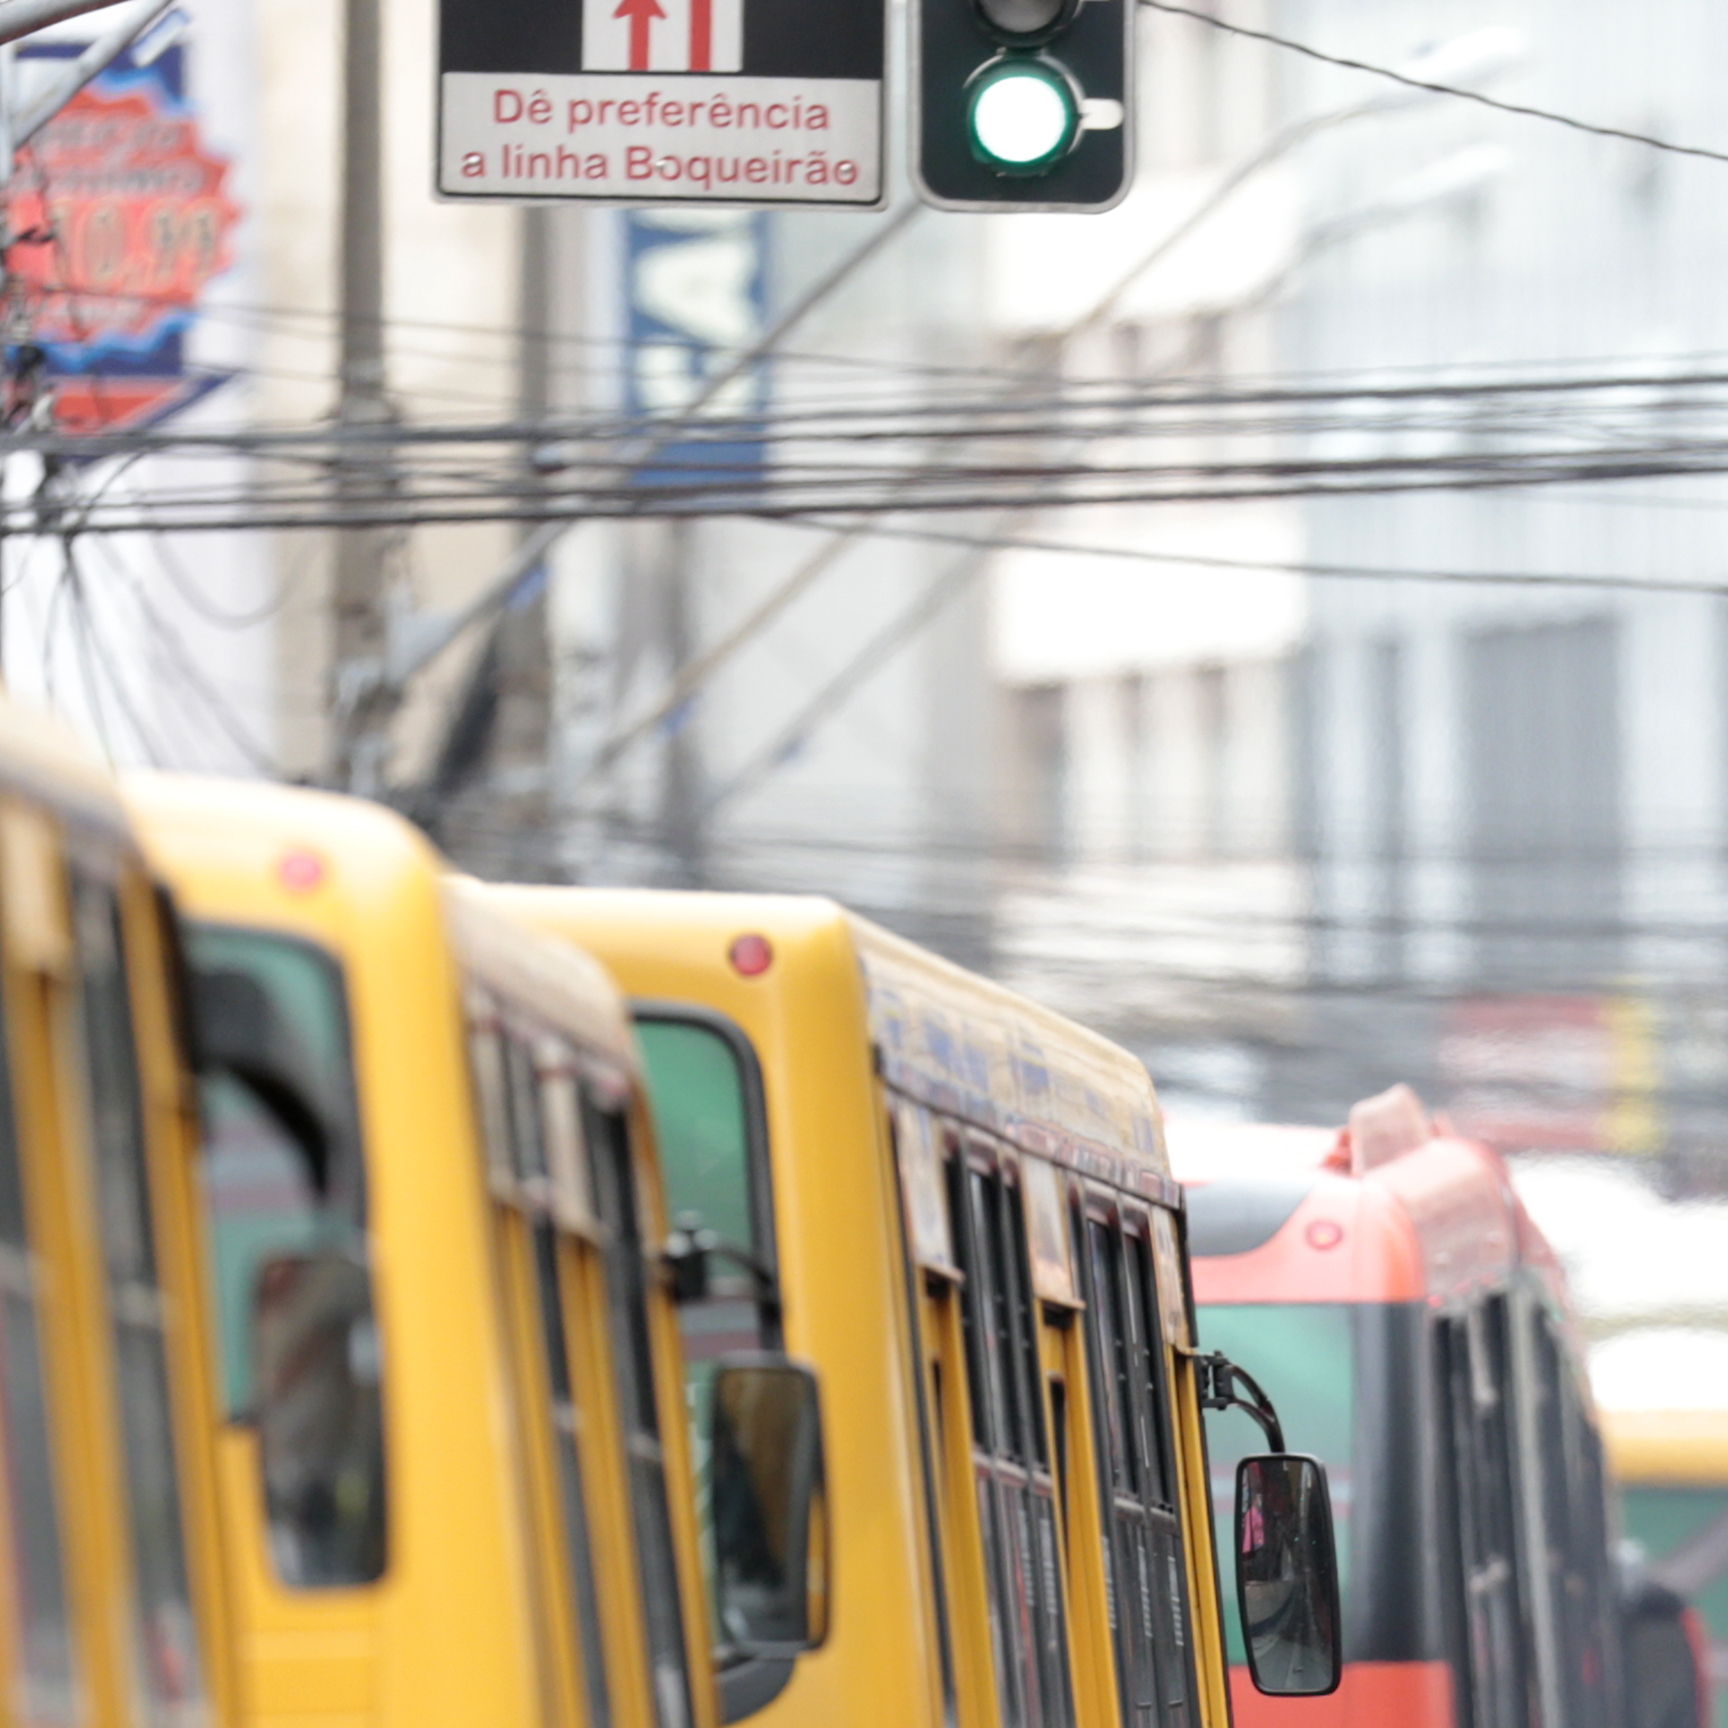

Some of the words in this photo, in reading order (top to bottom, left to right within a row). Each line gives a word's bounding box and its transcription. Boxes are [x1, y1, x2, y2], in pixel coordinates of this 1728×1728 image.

[492, 89, 554, 125] Dê
[568, 92, 830, 133] preferência
[460, 150, 486, 180] a
[500, 144, 609, 181] linha
[624, 145, 860, 190] Boqueirão
